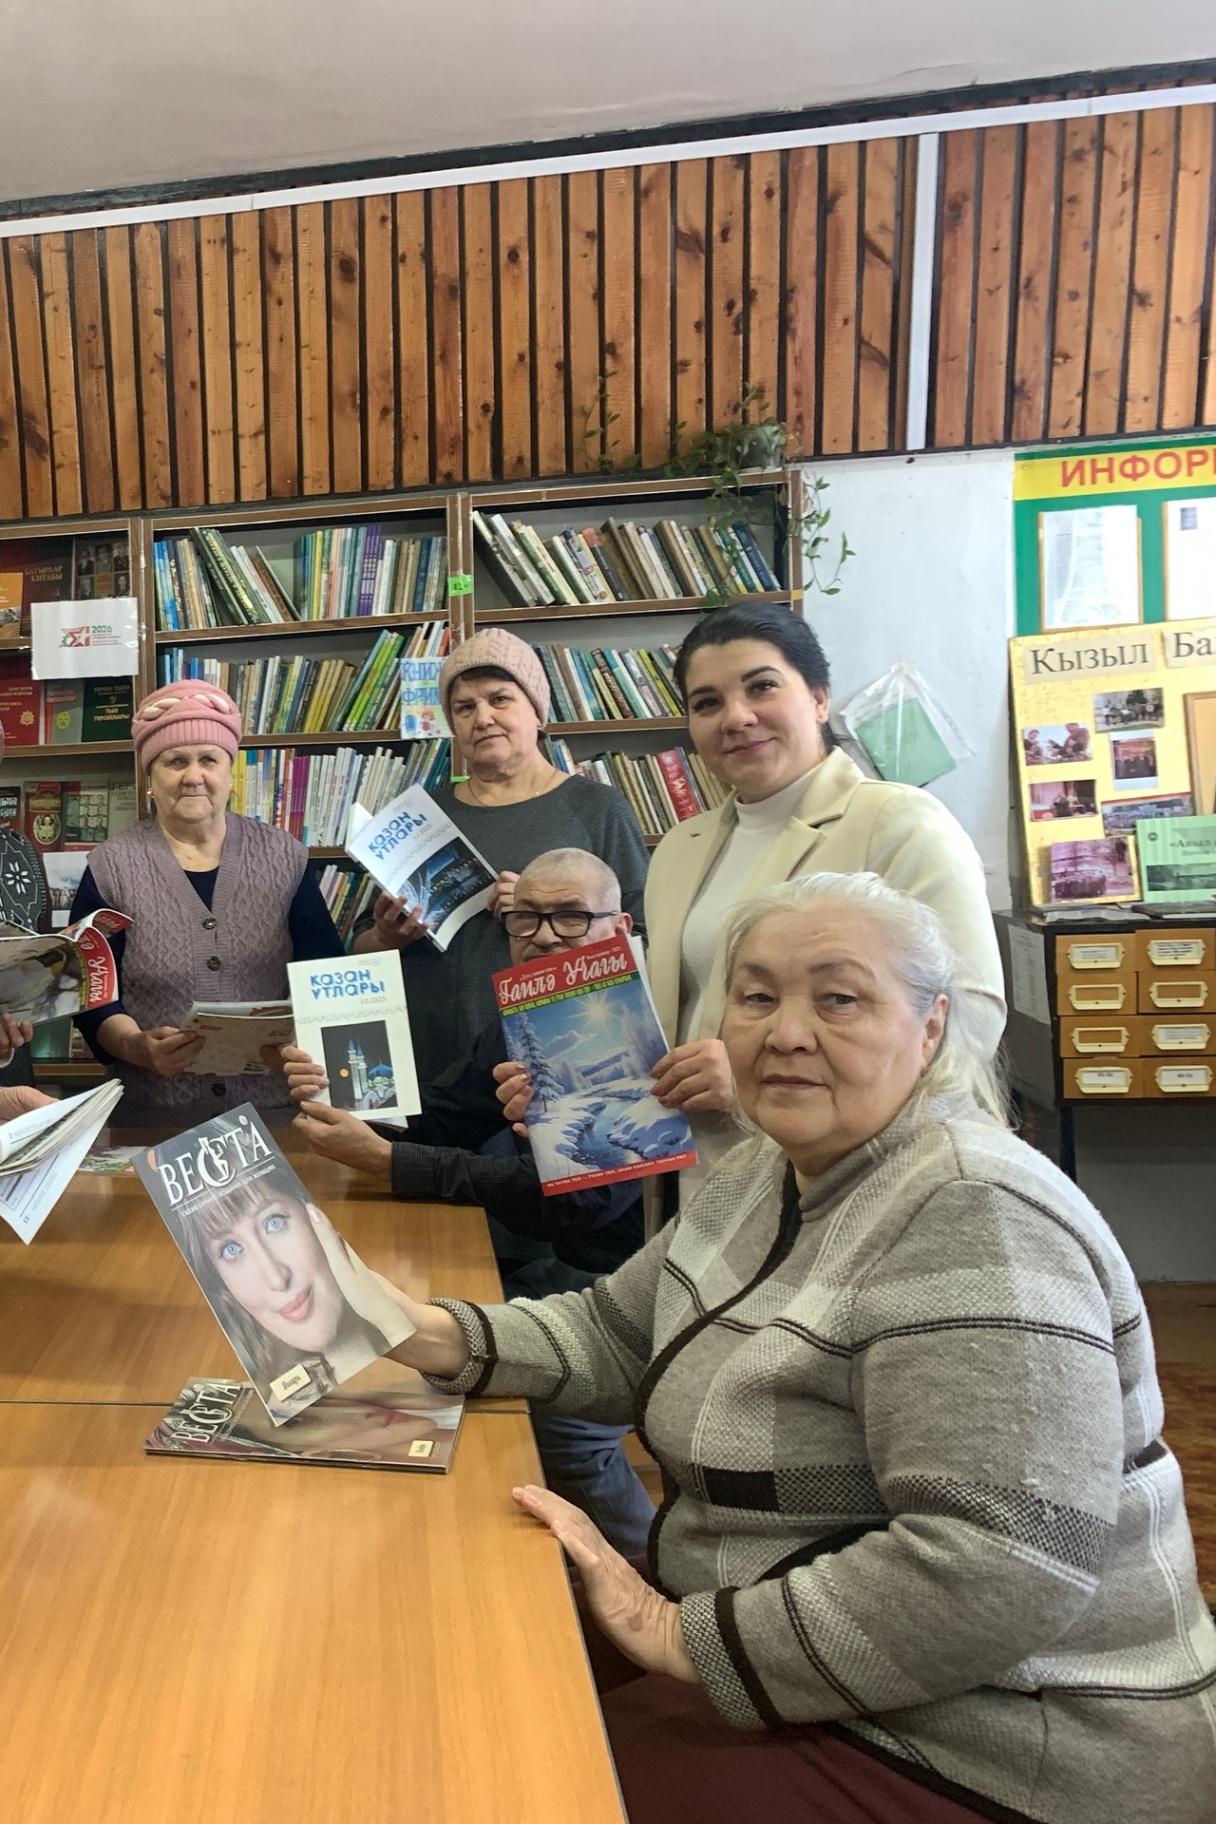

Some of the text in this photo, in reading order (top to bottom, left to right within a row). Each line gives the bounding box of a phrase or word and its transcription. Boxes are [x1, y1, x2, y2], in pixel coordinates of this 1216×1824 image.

[1061, 448, 1216, 488] ИНФОР
[92, 624, 113, 633] 2026
[1030, 632, 1216, 675] Кызыл Ба
